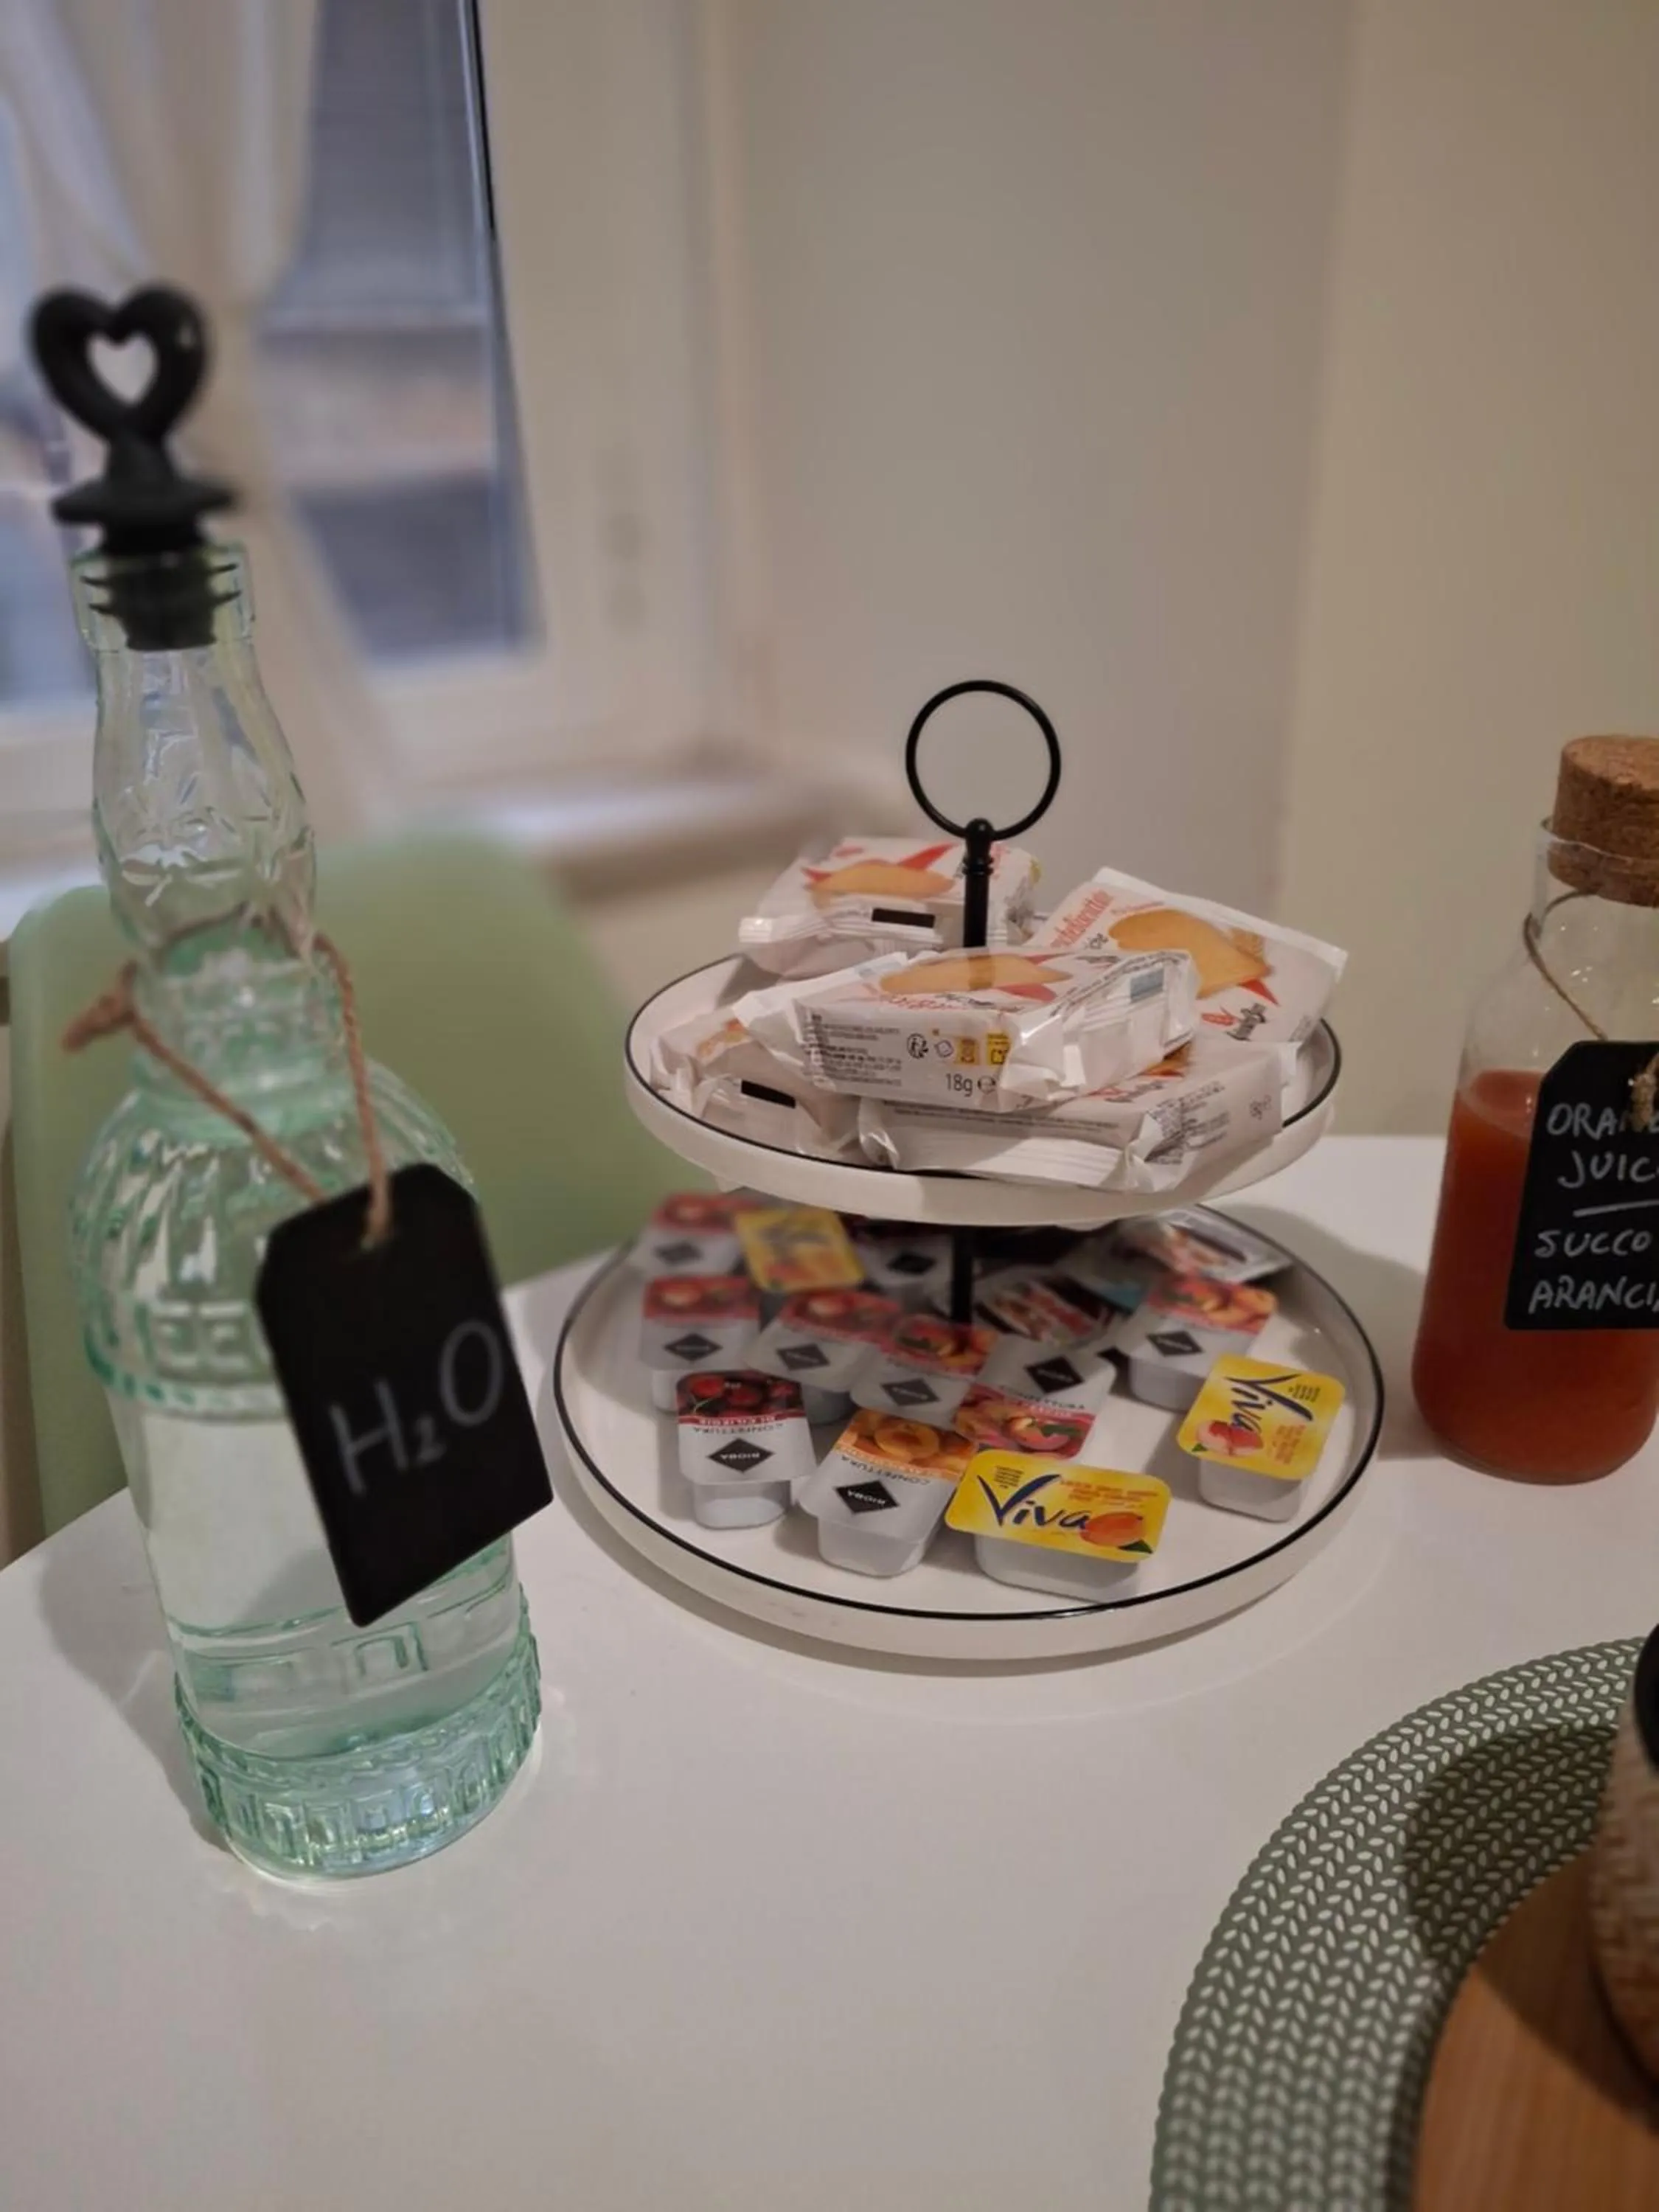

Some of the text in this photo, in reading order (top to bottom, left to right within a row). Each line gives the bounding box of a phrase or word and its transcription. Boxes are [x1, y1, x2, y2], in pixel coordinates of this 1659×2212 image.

[945, 1073, 973, 1098] 18g
[1557, 1149, 1659, 1189] JUIC
[1534, 1229, 1652, 1258] SUCCO
[1224, 1373, 1313, 1433] Viva
[719, 1451, 761, 1461] RIOBA
[846, 1489, 886, 1506] RIOBA
[976, 1473, 1092, 1529] Viva
